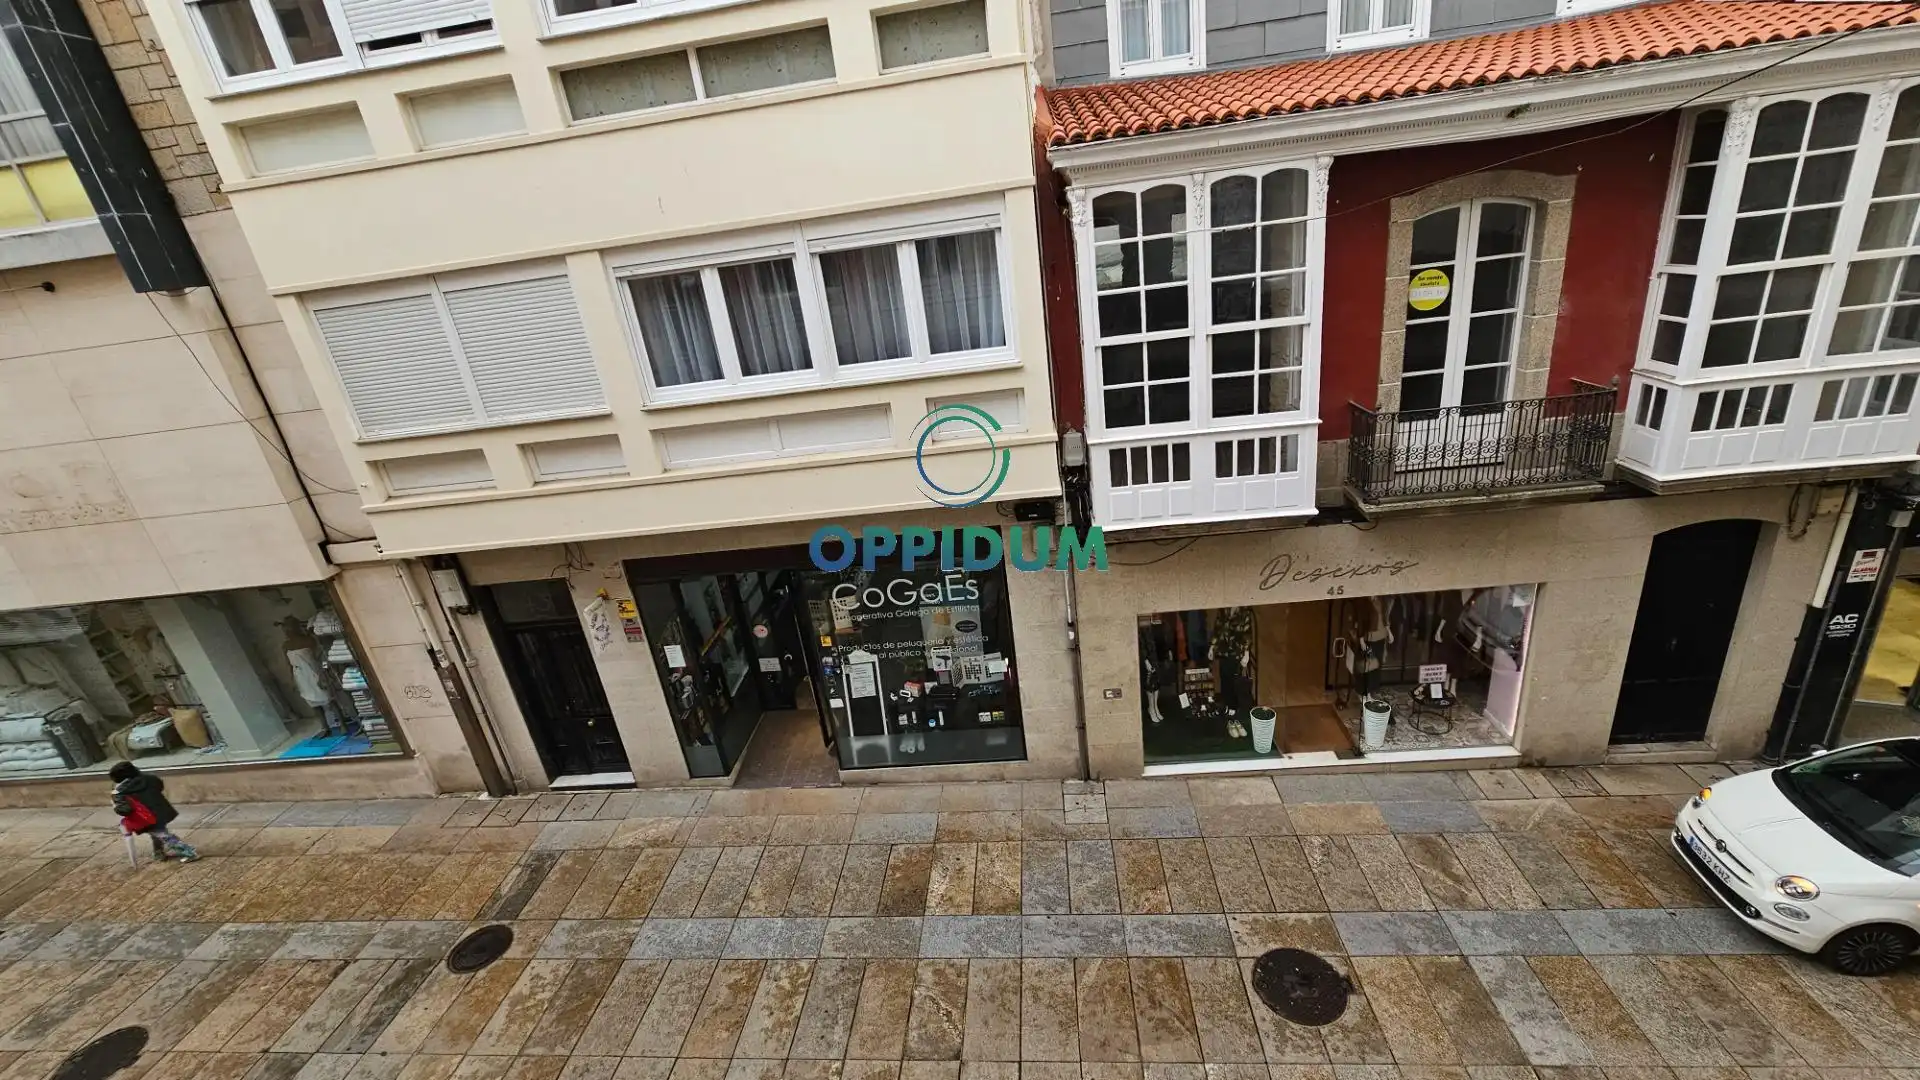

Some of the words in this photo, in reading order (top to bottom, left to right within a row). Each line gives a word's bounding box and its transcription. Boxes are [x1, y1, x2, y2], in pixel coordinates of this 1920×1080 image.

[1259, 554, 1419, 590] Desexos
[832, 573, 979, 609] CoGaEs
[1327, 586, 1344, 595] 45
[1829, 614, 1859, 624] AC
[838, 643, 881, 652] Productos
[883, 641, 895, 649] de
